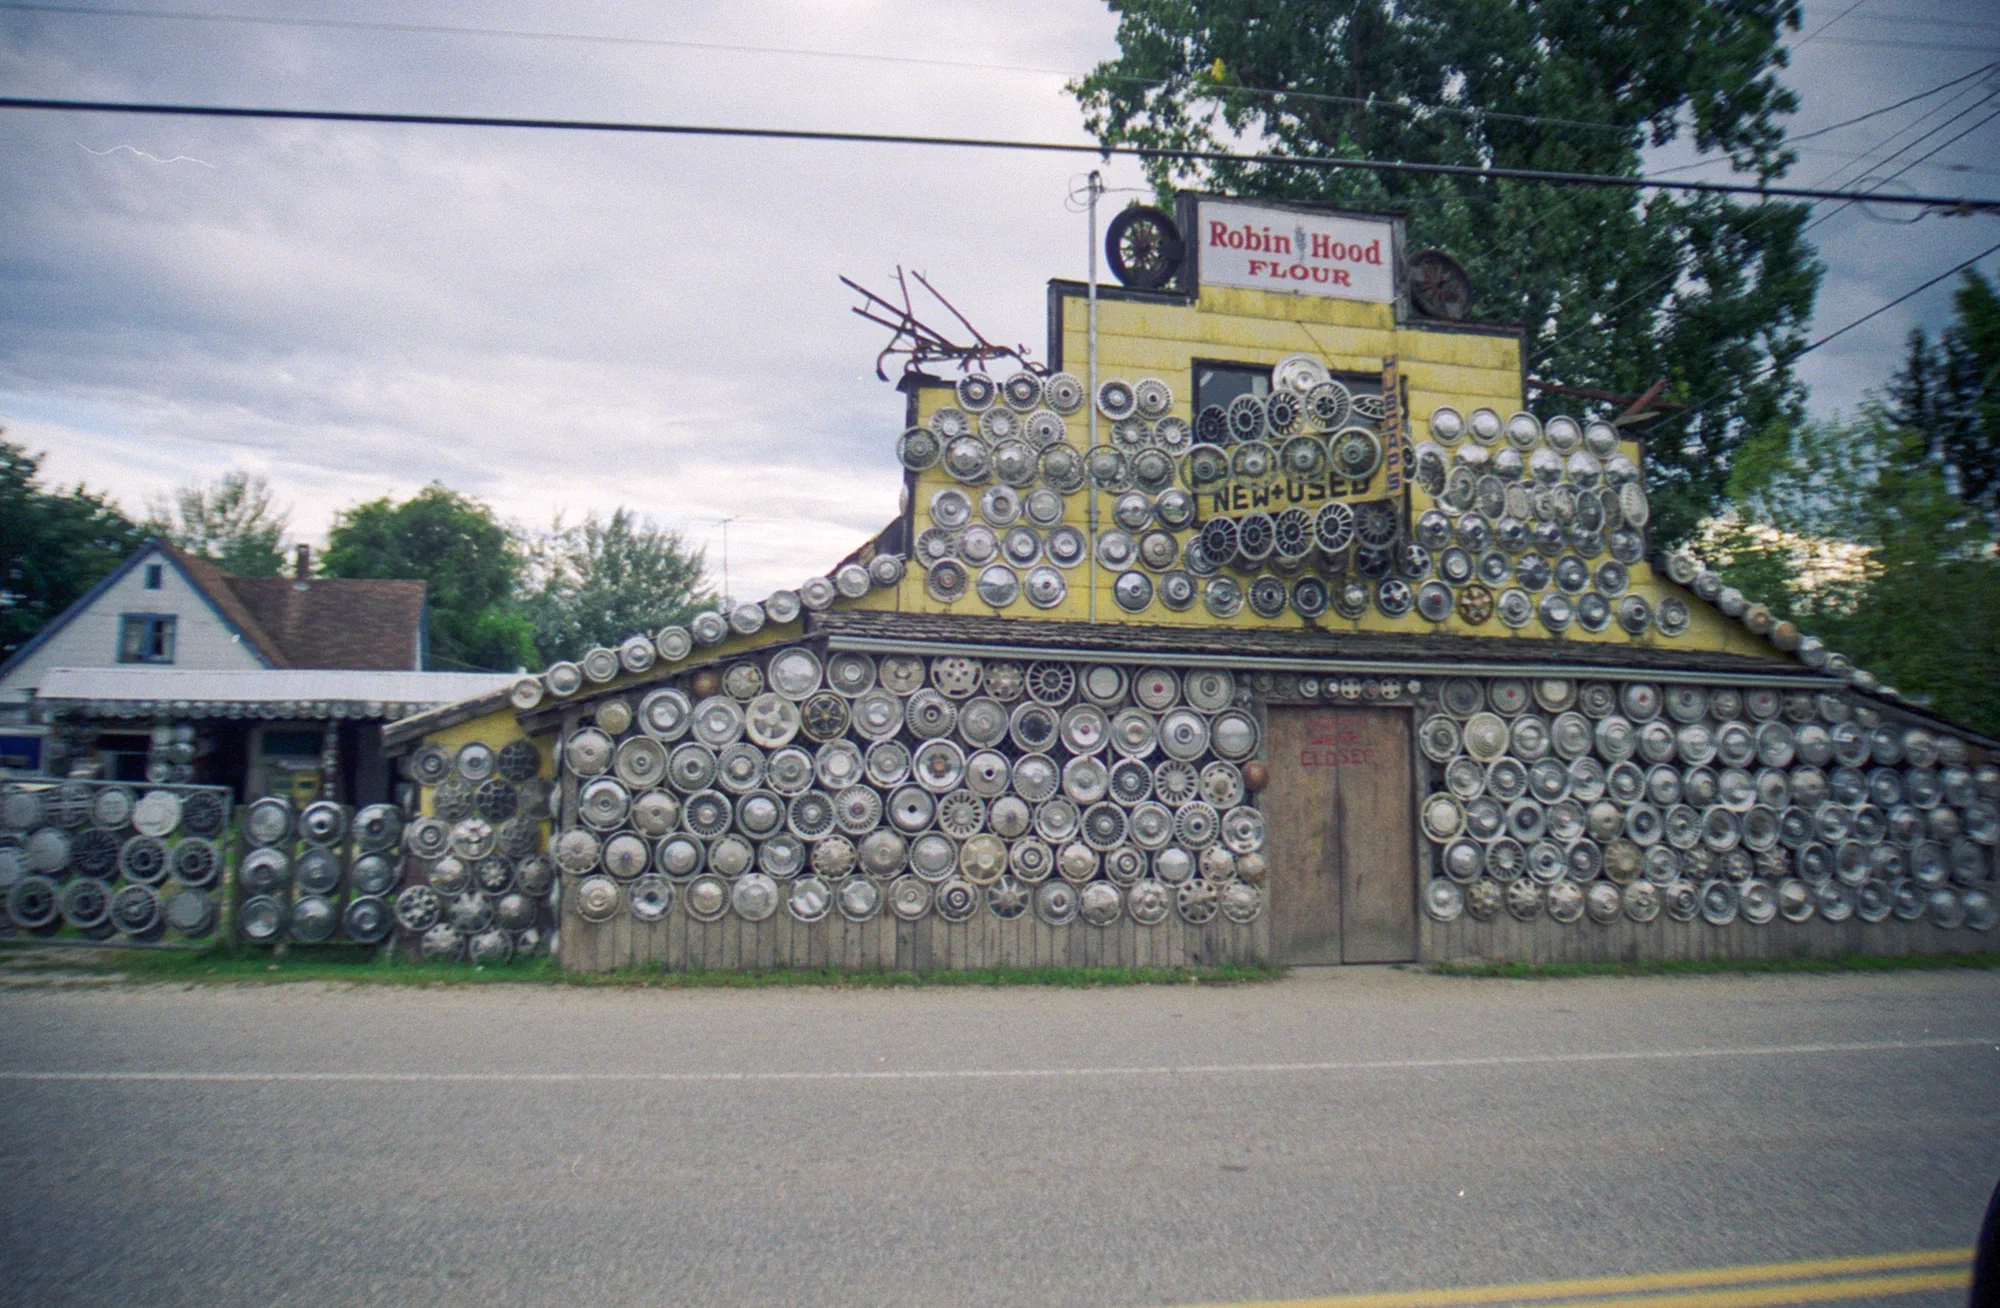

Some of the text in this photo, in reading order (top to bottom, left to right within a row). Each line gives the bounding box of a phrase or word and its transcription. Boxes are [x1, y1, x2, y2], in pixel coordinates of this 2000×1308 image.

[1209, 220, 1382, 266] Robin Hood
[1248, 259, 1352, 287] FLOUR
[1301, 749, 1375, 767] CLOSED
